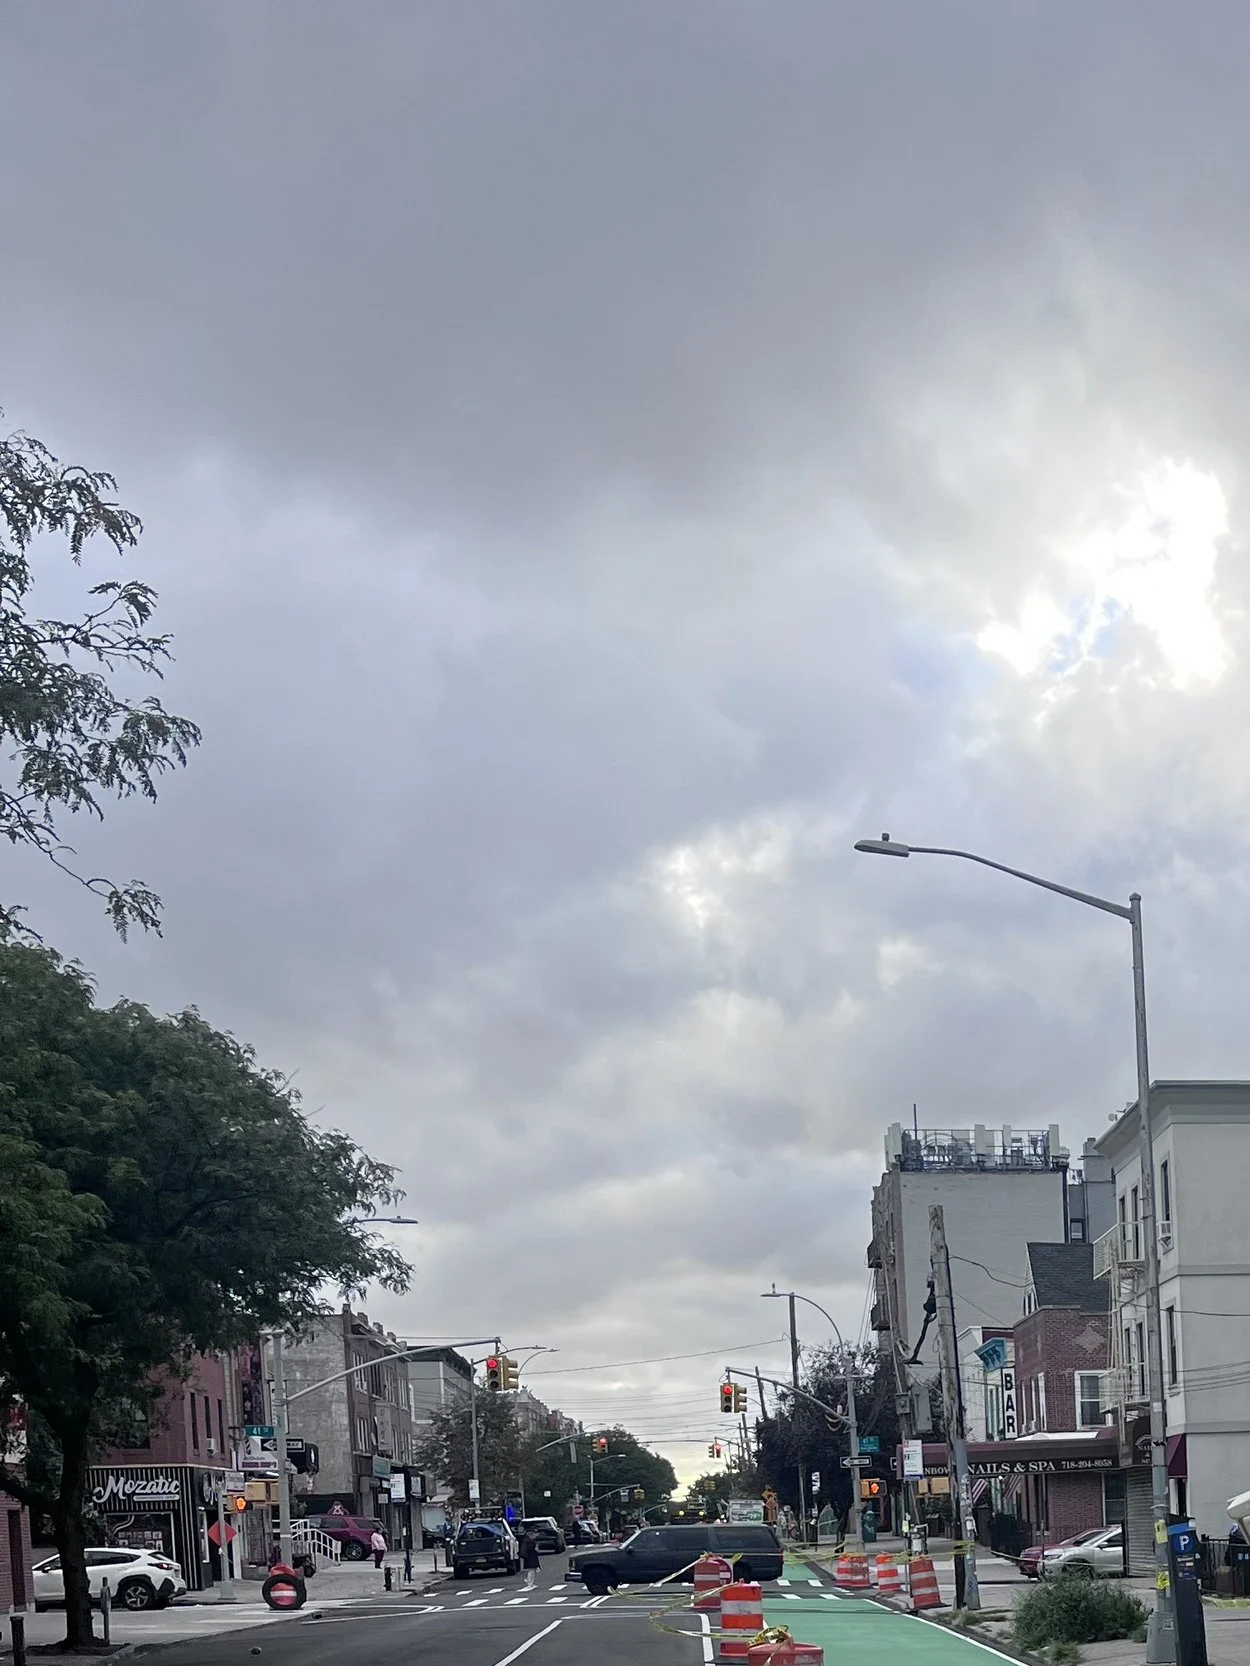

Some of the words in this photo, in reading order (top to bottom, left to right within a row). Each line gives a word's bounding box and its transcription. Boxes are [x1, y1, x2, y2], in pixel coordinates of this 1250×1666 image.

[1004, 1373, 1016, 1433] BAR
[968, 1462, 1010, 1474] NAILS
[1014, 1462, 1025, 1472] &
[1029, 1461, 1056, 1472] SPA
[92, 1476, 180, 1503] Mozatic
[1179, 1535, 1190, 1550] P
